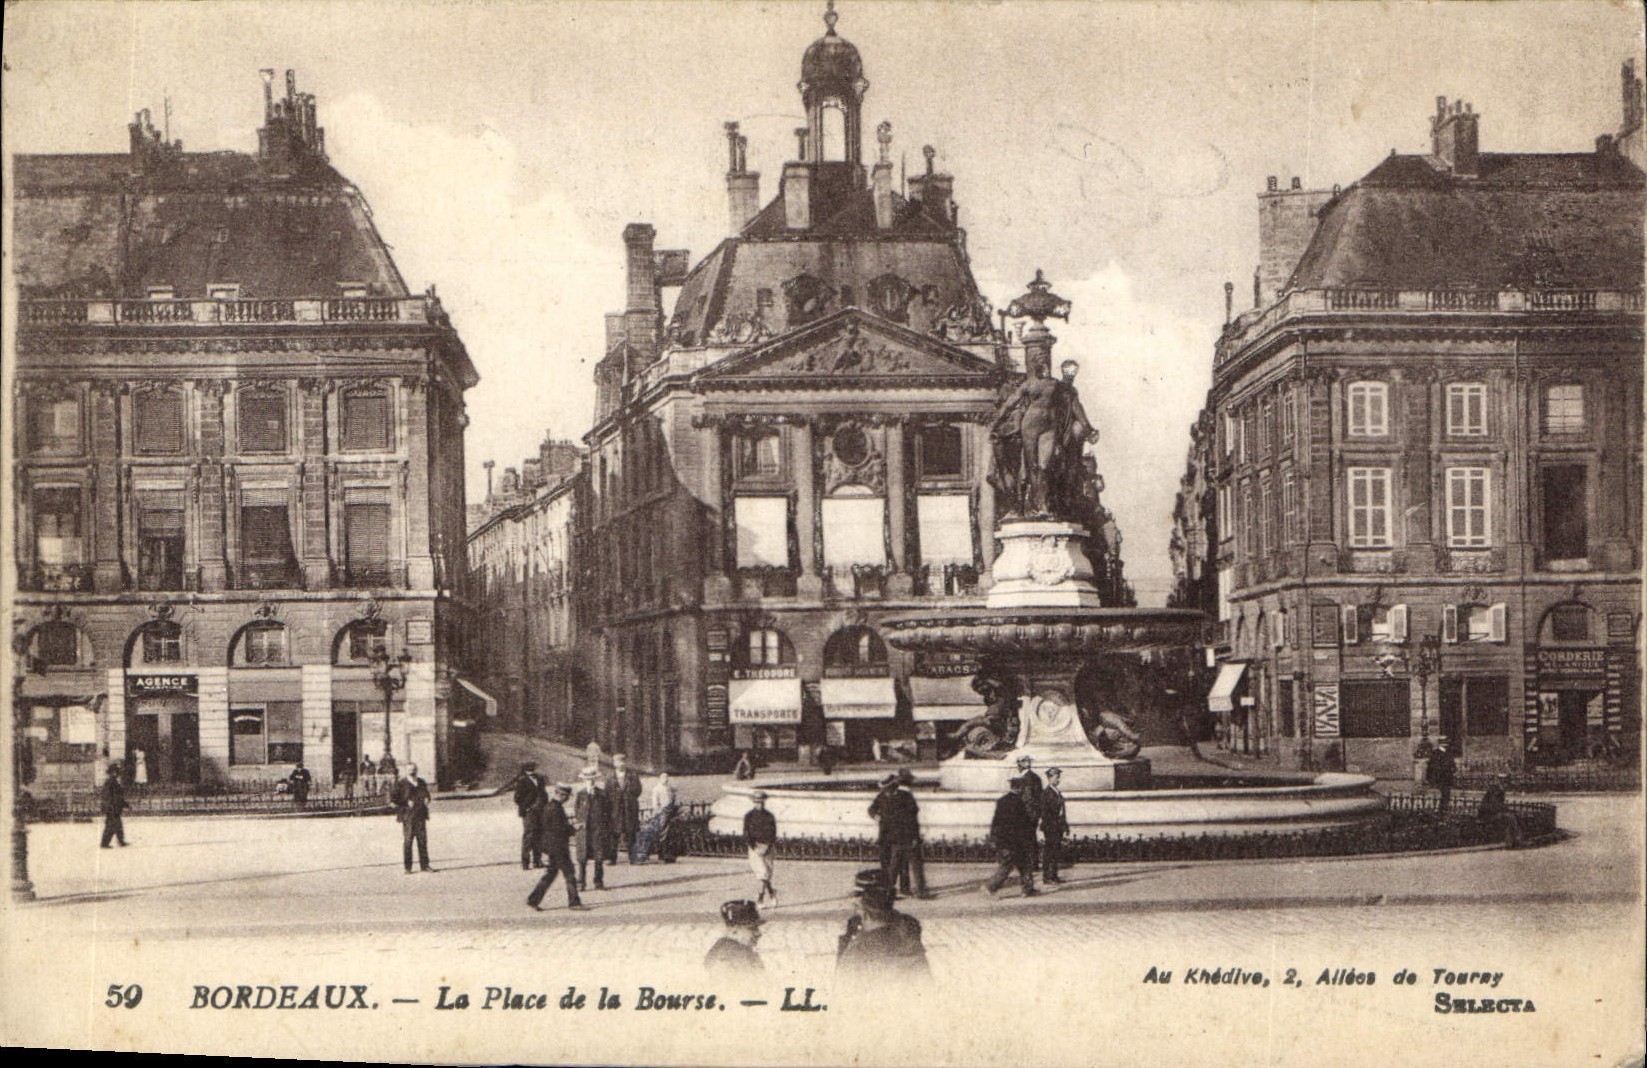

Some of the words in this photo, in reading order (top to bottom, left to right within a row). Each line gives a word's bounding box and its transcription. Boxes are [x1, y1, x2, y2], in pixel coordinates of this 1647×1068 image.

[1540, 651, 1604, 661] CORDERIE
[922, 665, 970, 675] ABACS
[136, 677, 188, 686] AGENCE
